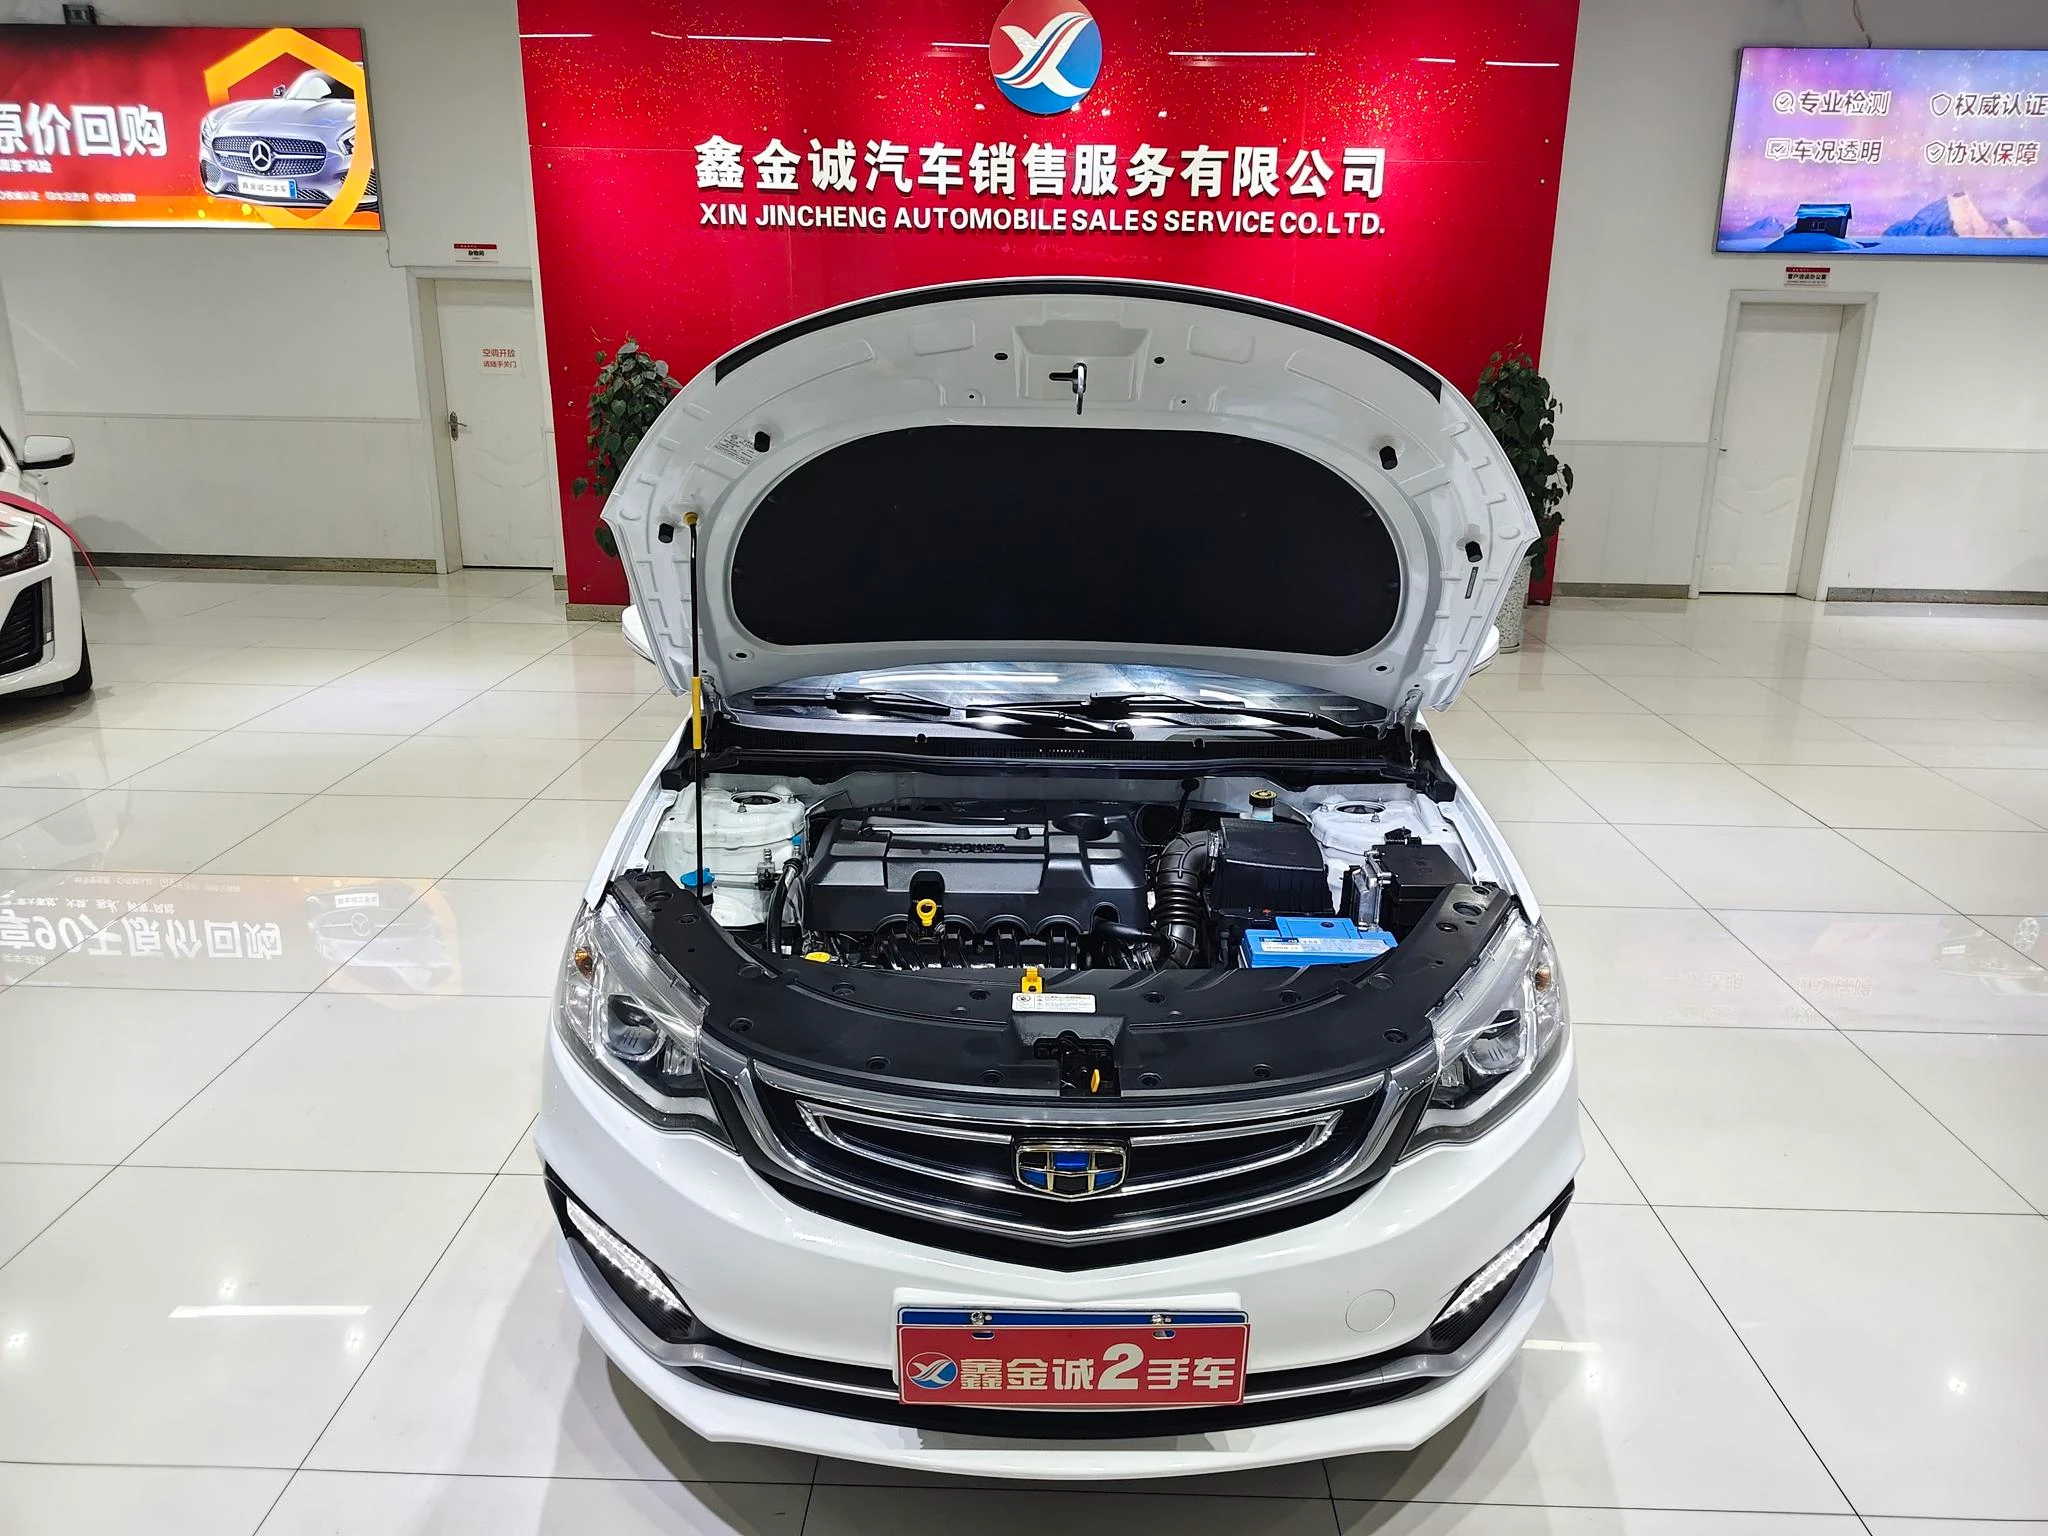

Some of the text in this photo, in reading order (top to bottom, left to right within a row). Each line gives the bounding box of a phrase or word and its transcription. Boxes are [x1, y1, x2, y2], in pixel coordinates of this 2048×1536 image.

[1798, 90, 1891, 116] 专业检测
[1953, 92, 2048, 117] 权威认证
[0, 102, 168, 157] 原价回购
[1791, 139, 1882, 164] 车况透明
[1946, 141, 2040, 166] 协议保障
[694, 135, 1386, 199] 鑫金诚汽车销售服务有限公司
[699, 202, 748, 227] XIN
[754, 204, 888, 230] JINCHENG
[893, 206, 1067, 232] AUTOMOBILE
[1070, 209, 1159, 232] SALES
[1163, 211, 1276, 234] SERVICE
[482, 348, 516, 358] 空调开放
[959, 1342, 1236, 1391] 鑫金诚2手车
